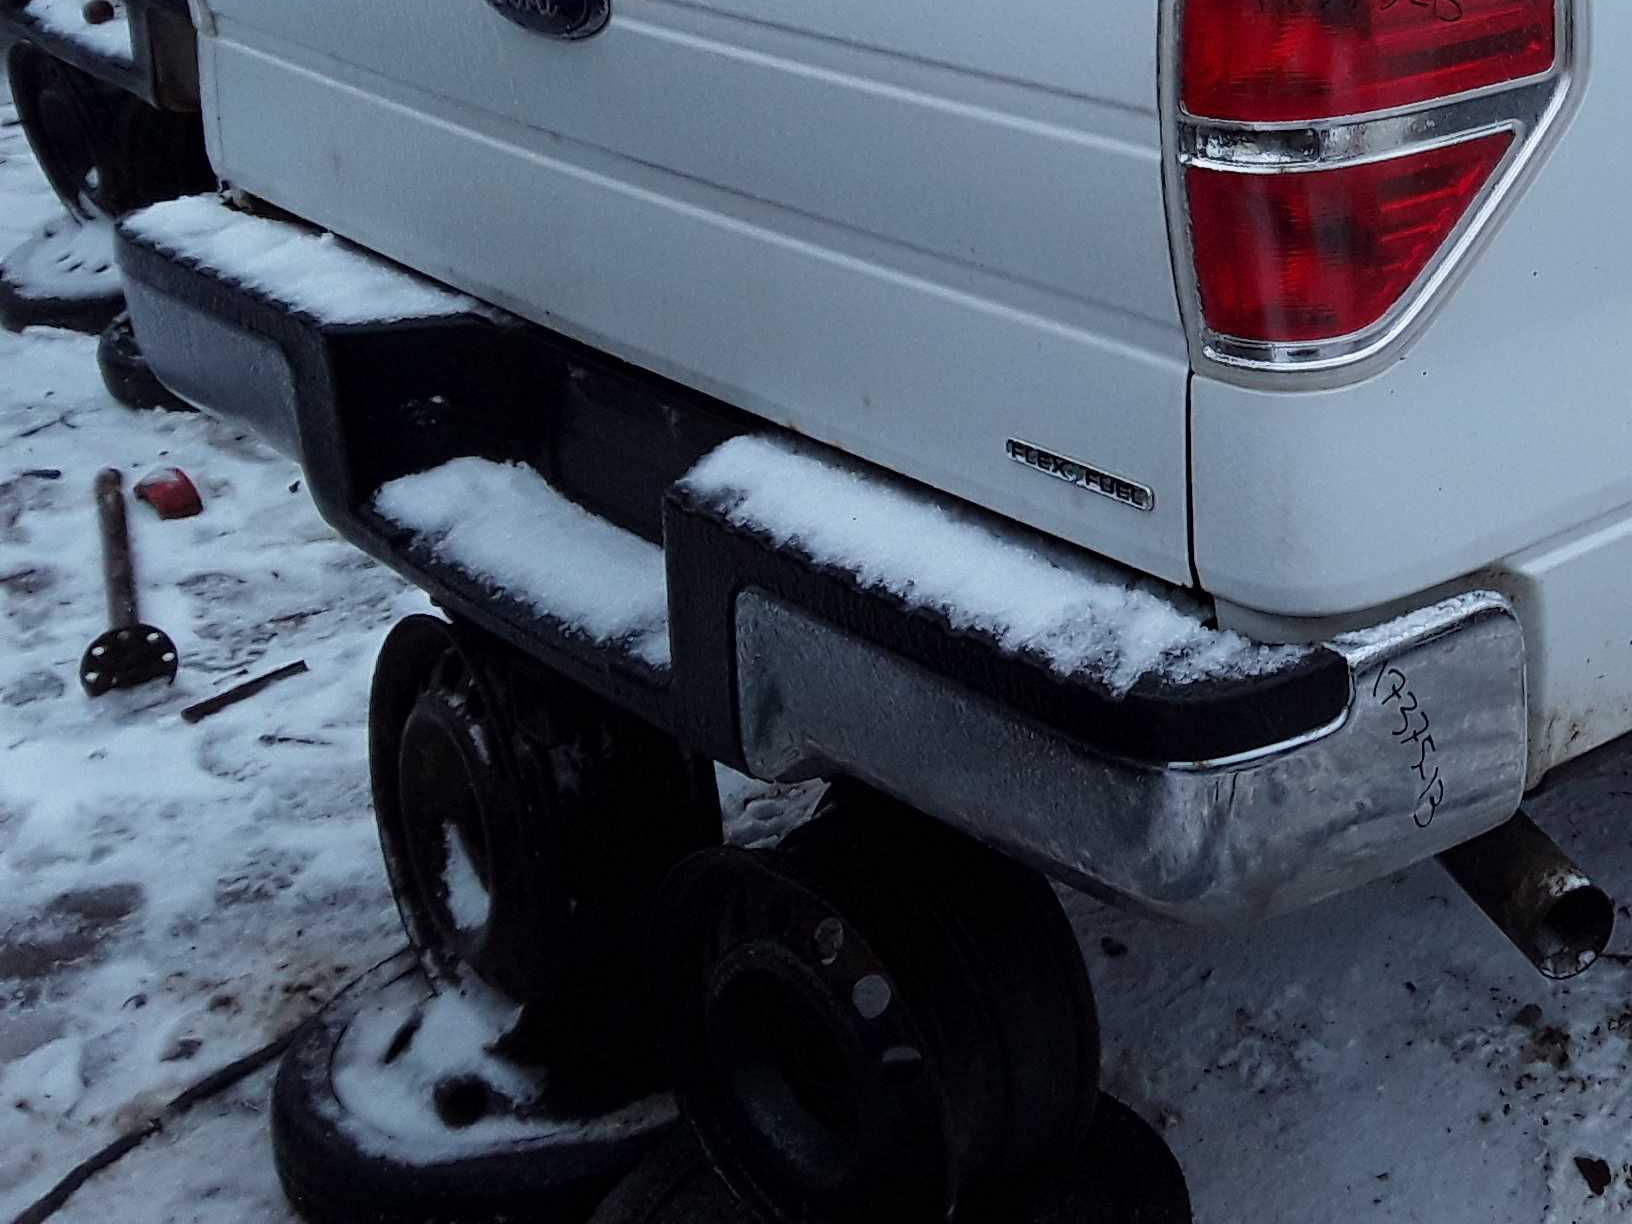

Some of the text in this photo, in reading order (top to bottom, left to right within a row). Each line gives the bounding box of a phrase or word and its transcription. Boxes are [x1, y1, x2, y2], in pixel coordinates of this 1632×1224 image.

[1010, 438, 1147, 507] FLEX FUEL
[1372, 660, 1444, 828] 17375-13
